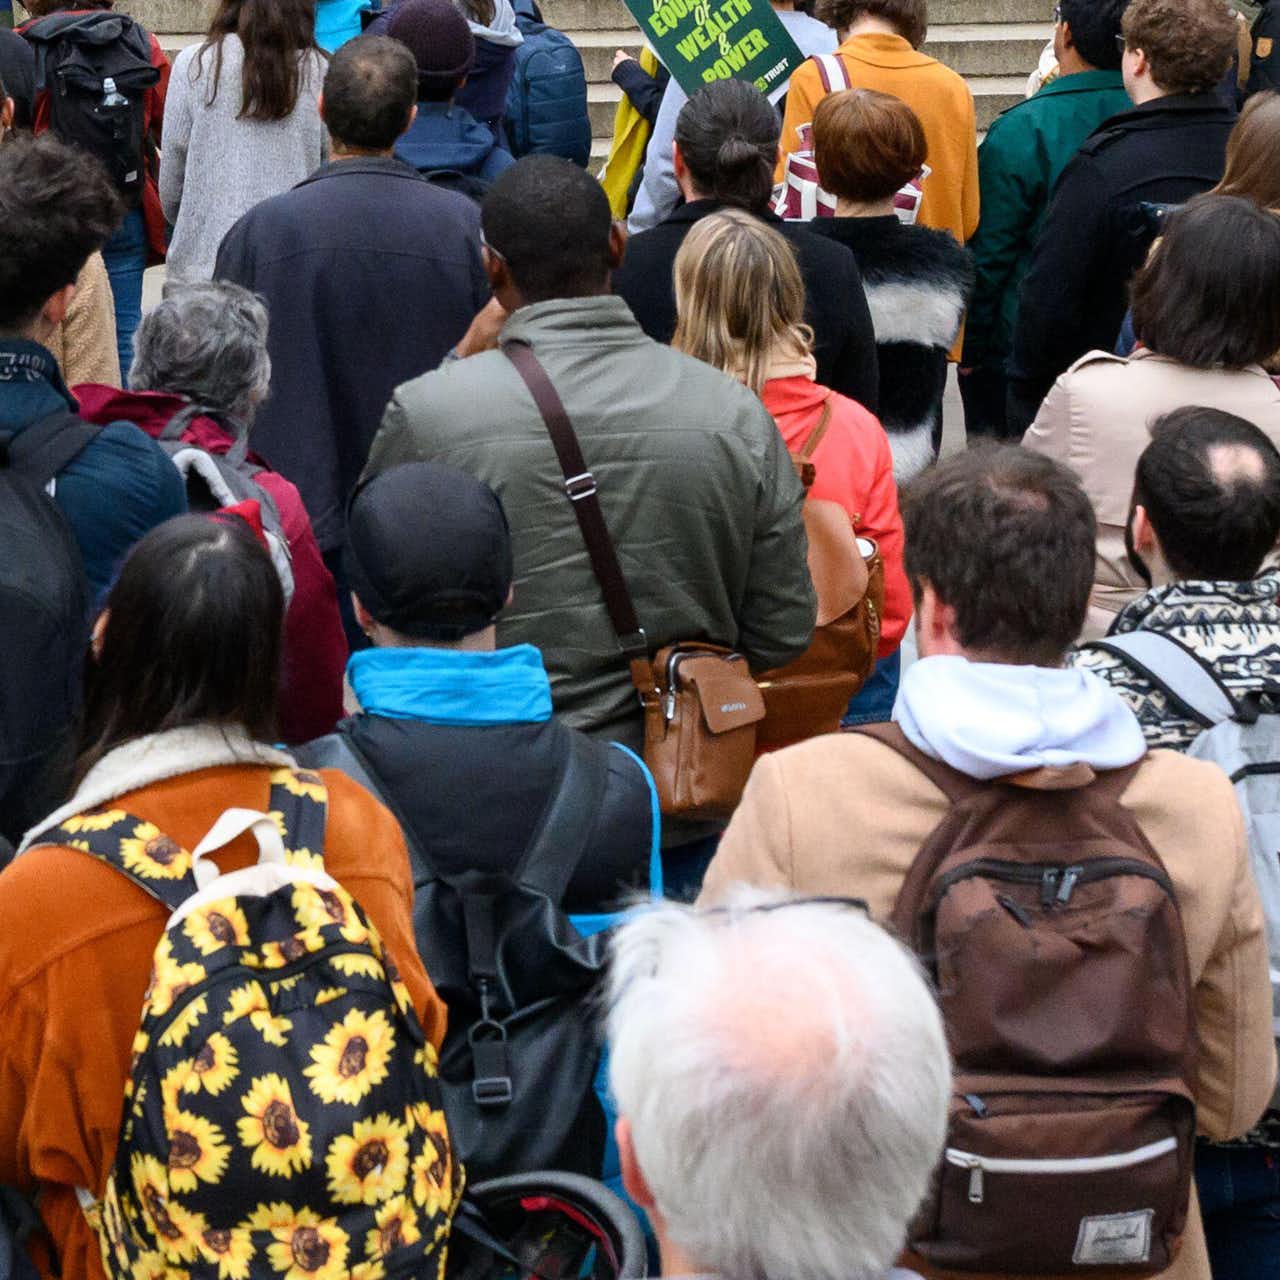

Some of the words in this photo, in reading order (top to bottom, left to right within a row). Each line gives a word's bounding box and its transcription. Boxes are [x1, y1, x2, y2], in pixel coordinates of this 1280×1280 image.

[702, 28, 769, 83] POWER
[718, 31, 732, 56] &
[763, 57, 789, 83] TRUST
